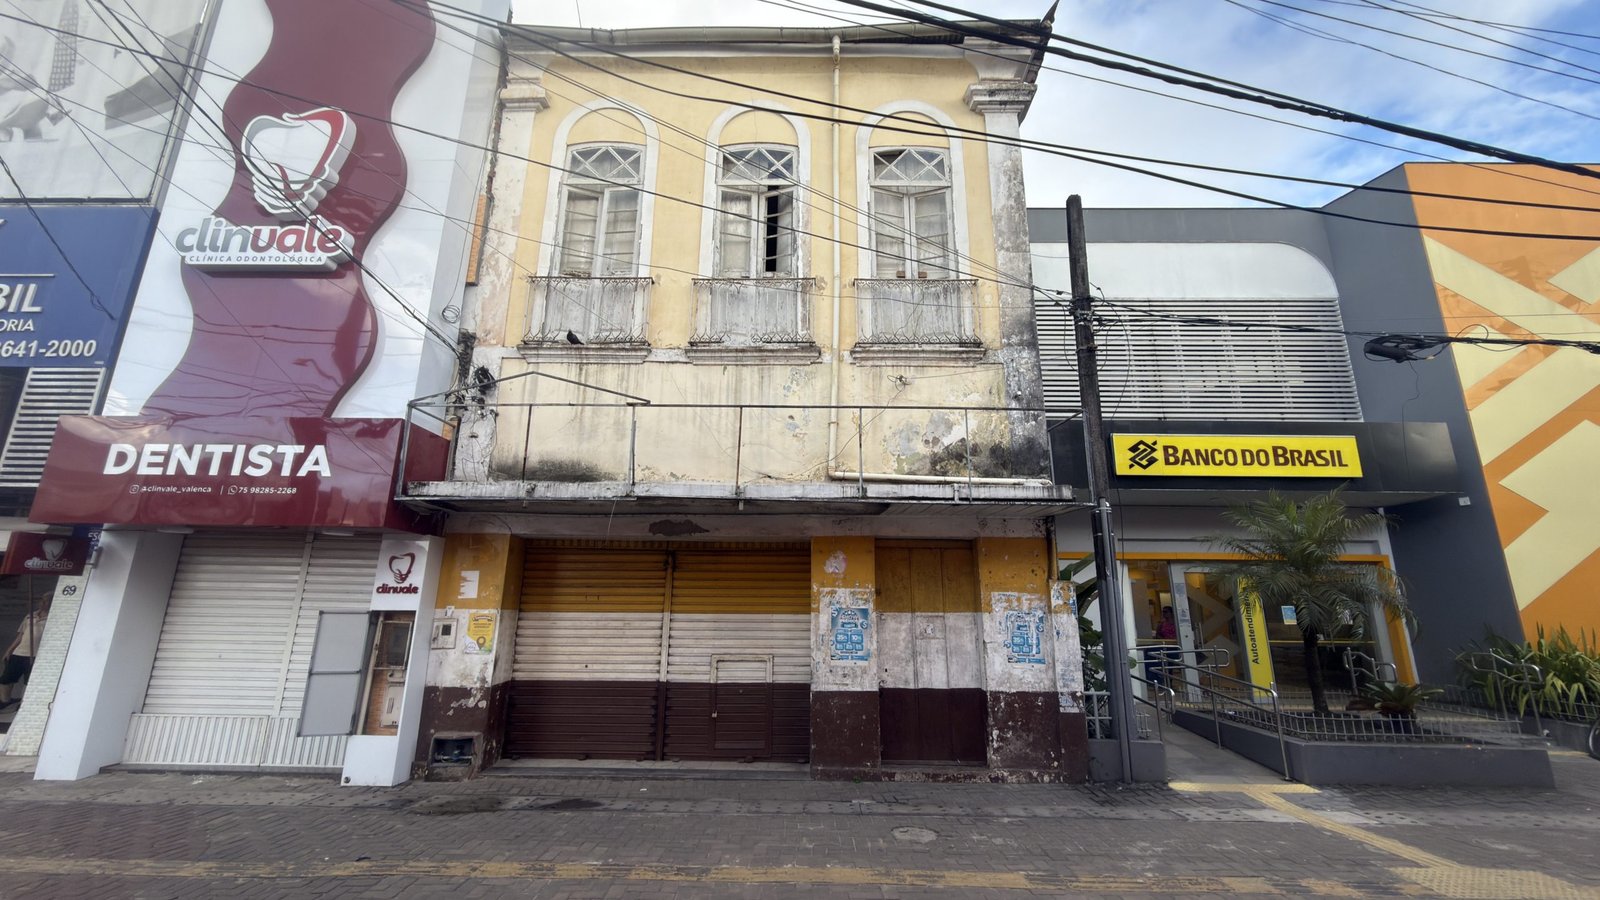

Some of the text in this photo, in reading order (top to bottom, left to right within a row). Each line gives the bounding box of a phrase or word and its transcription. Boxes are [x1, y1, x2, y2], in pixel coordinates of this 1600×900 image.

[176, 216, 343, 253] clinvale
[189, 254, 323, 263] CLÍNICA ODONTOLÓGICA
[0, 340, 97, 357] 641-2000
[103, 443, 331, 477] DENTISTA
[1163, 445, 1238, 466] BANCO
[1272, 445, 1349, 468] BRASIL
[250, 486, 297, 494] 98285-2268
[62, 585, 77, 596] 69
